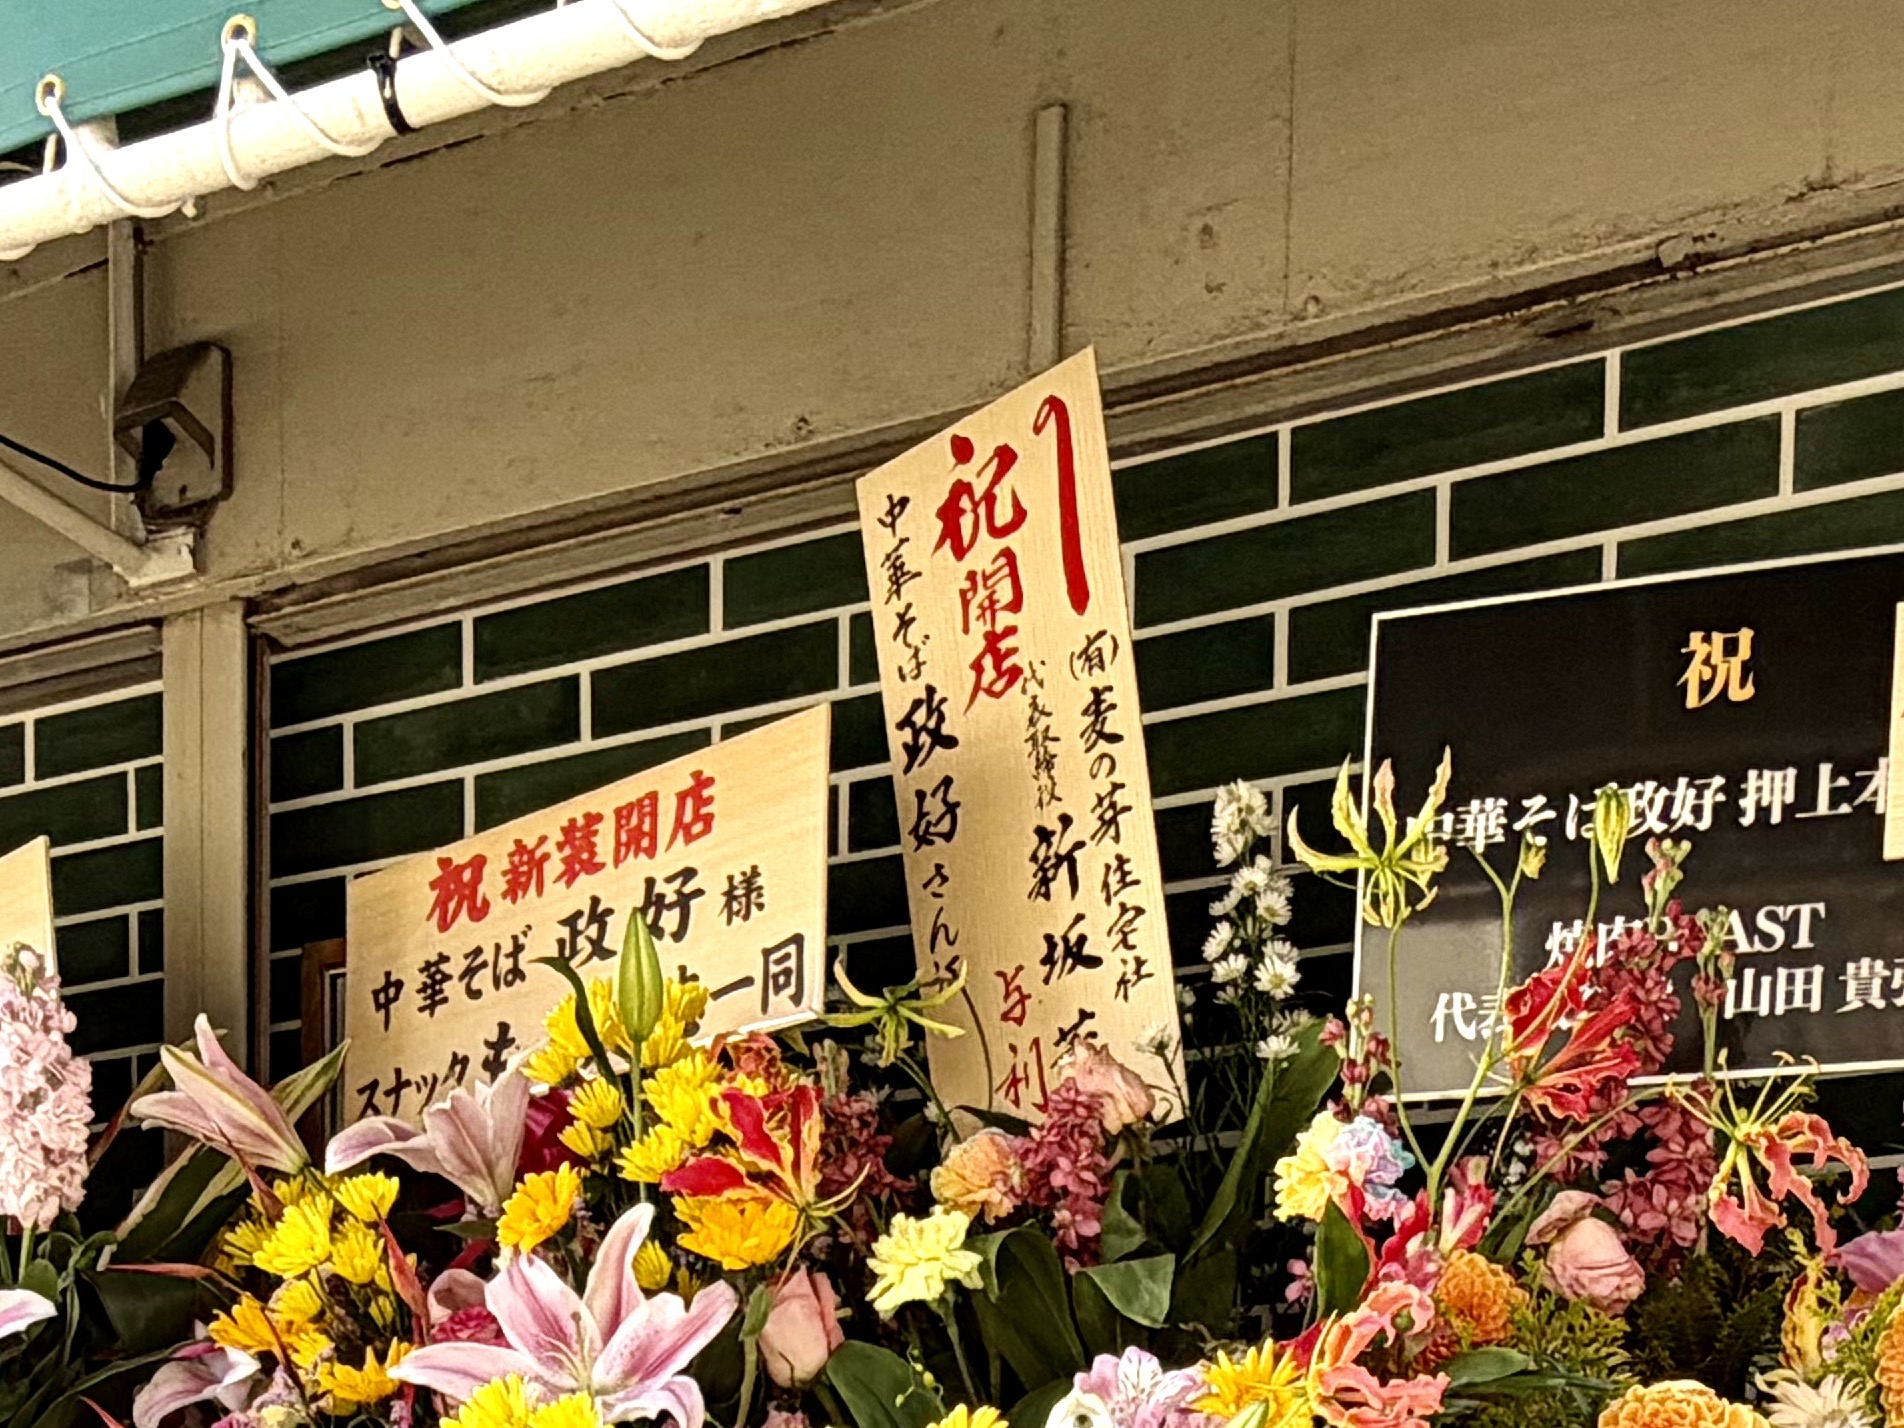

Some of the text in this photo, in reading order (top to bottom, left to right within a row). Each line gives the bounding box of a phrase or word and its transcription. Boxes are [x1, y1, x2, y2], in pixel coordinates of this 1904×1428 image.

[932, 433, 1028, 716] 祝開店
[1677, 626, 1756, 709] 祝
[426, 769, 718, 934] 祝新装開店
[1723, 965, 1824, 1020] 山田
